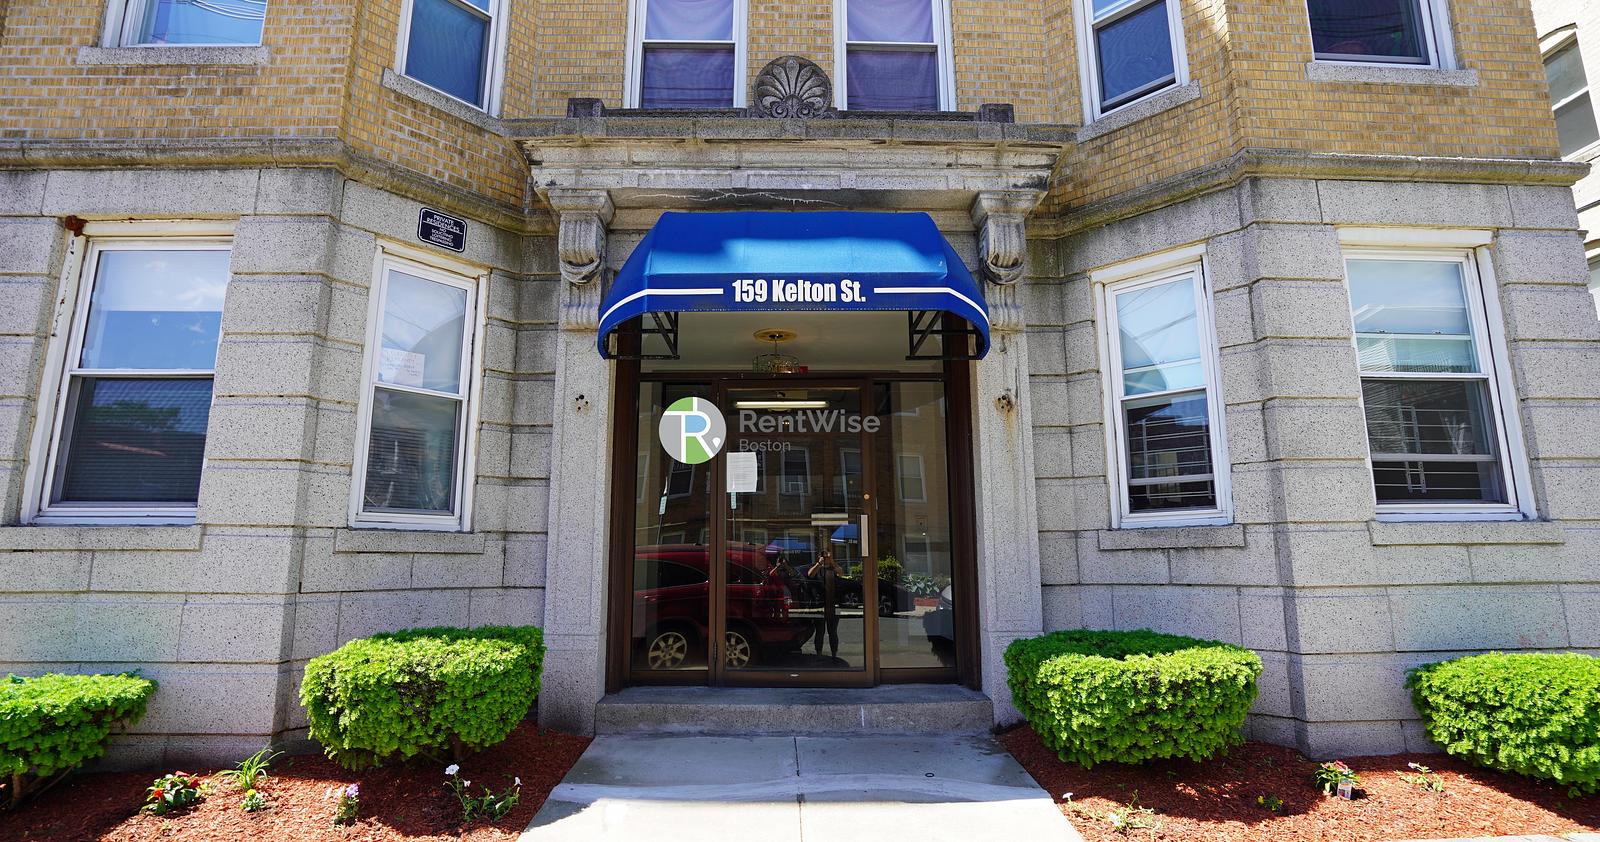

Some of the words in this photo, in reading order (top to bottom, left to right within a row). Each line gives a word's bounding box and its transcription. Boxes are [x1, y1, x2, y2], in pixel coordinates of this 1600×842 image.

[426, 218, 460, 232] RESIDENCES
[433, 215, 455, 226] PRIVATE
[732, 279, 767, 303] 159
[772, 279, 837, 303] Kelton
[840, 279, 867, 303] St.
